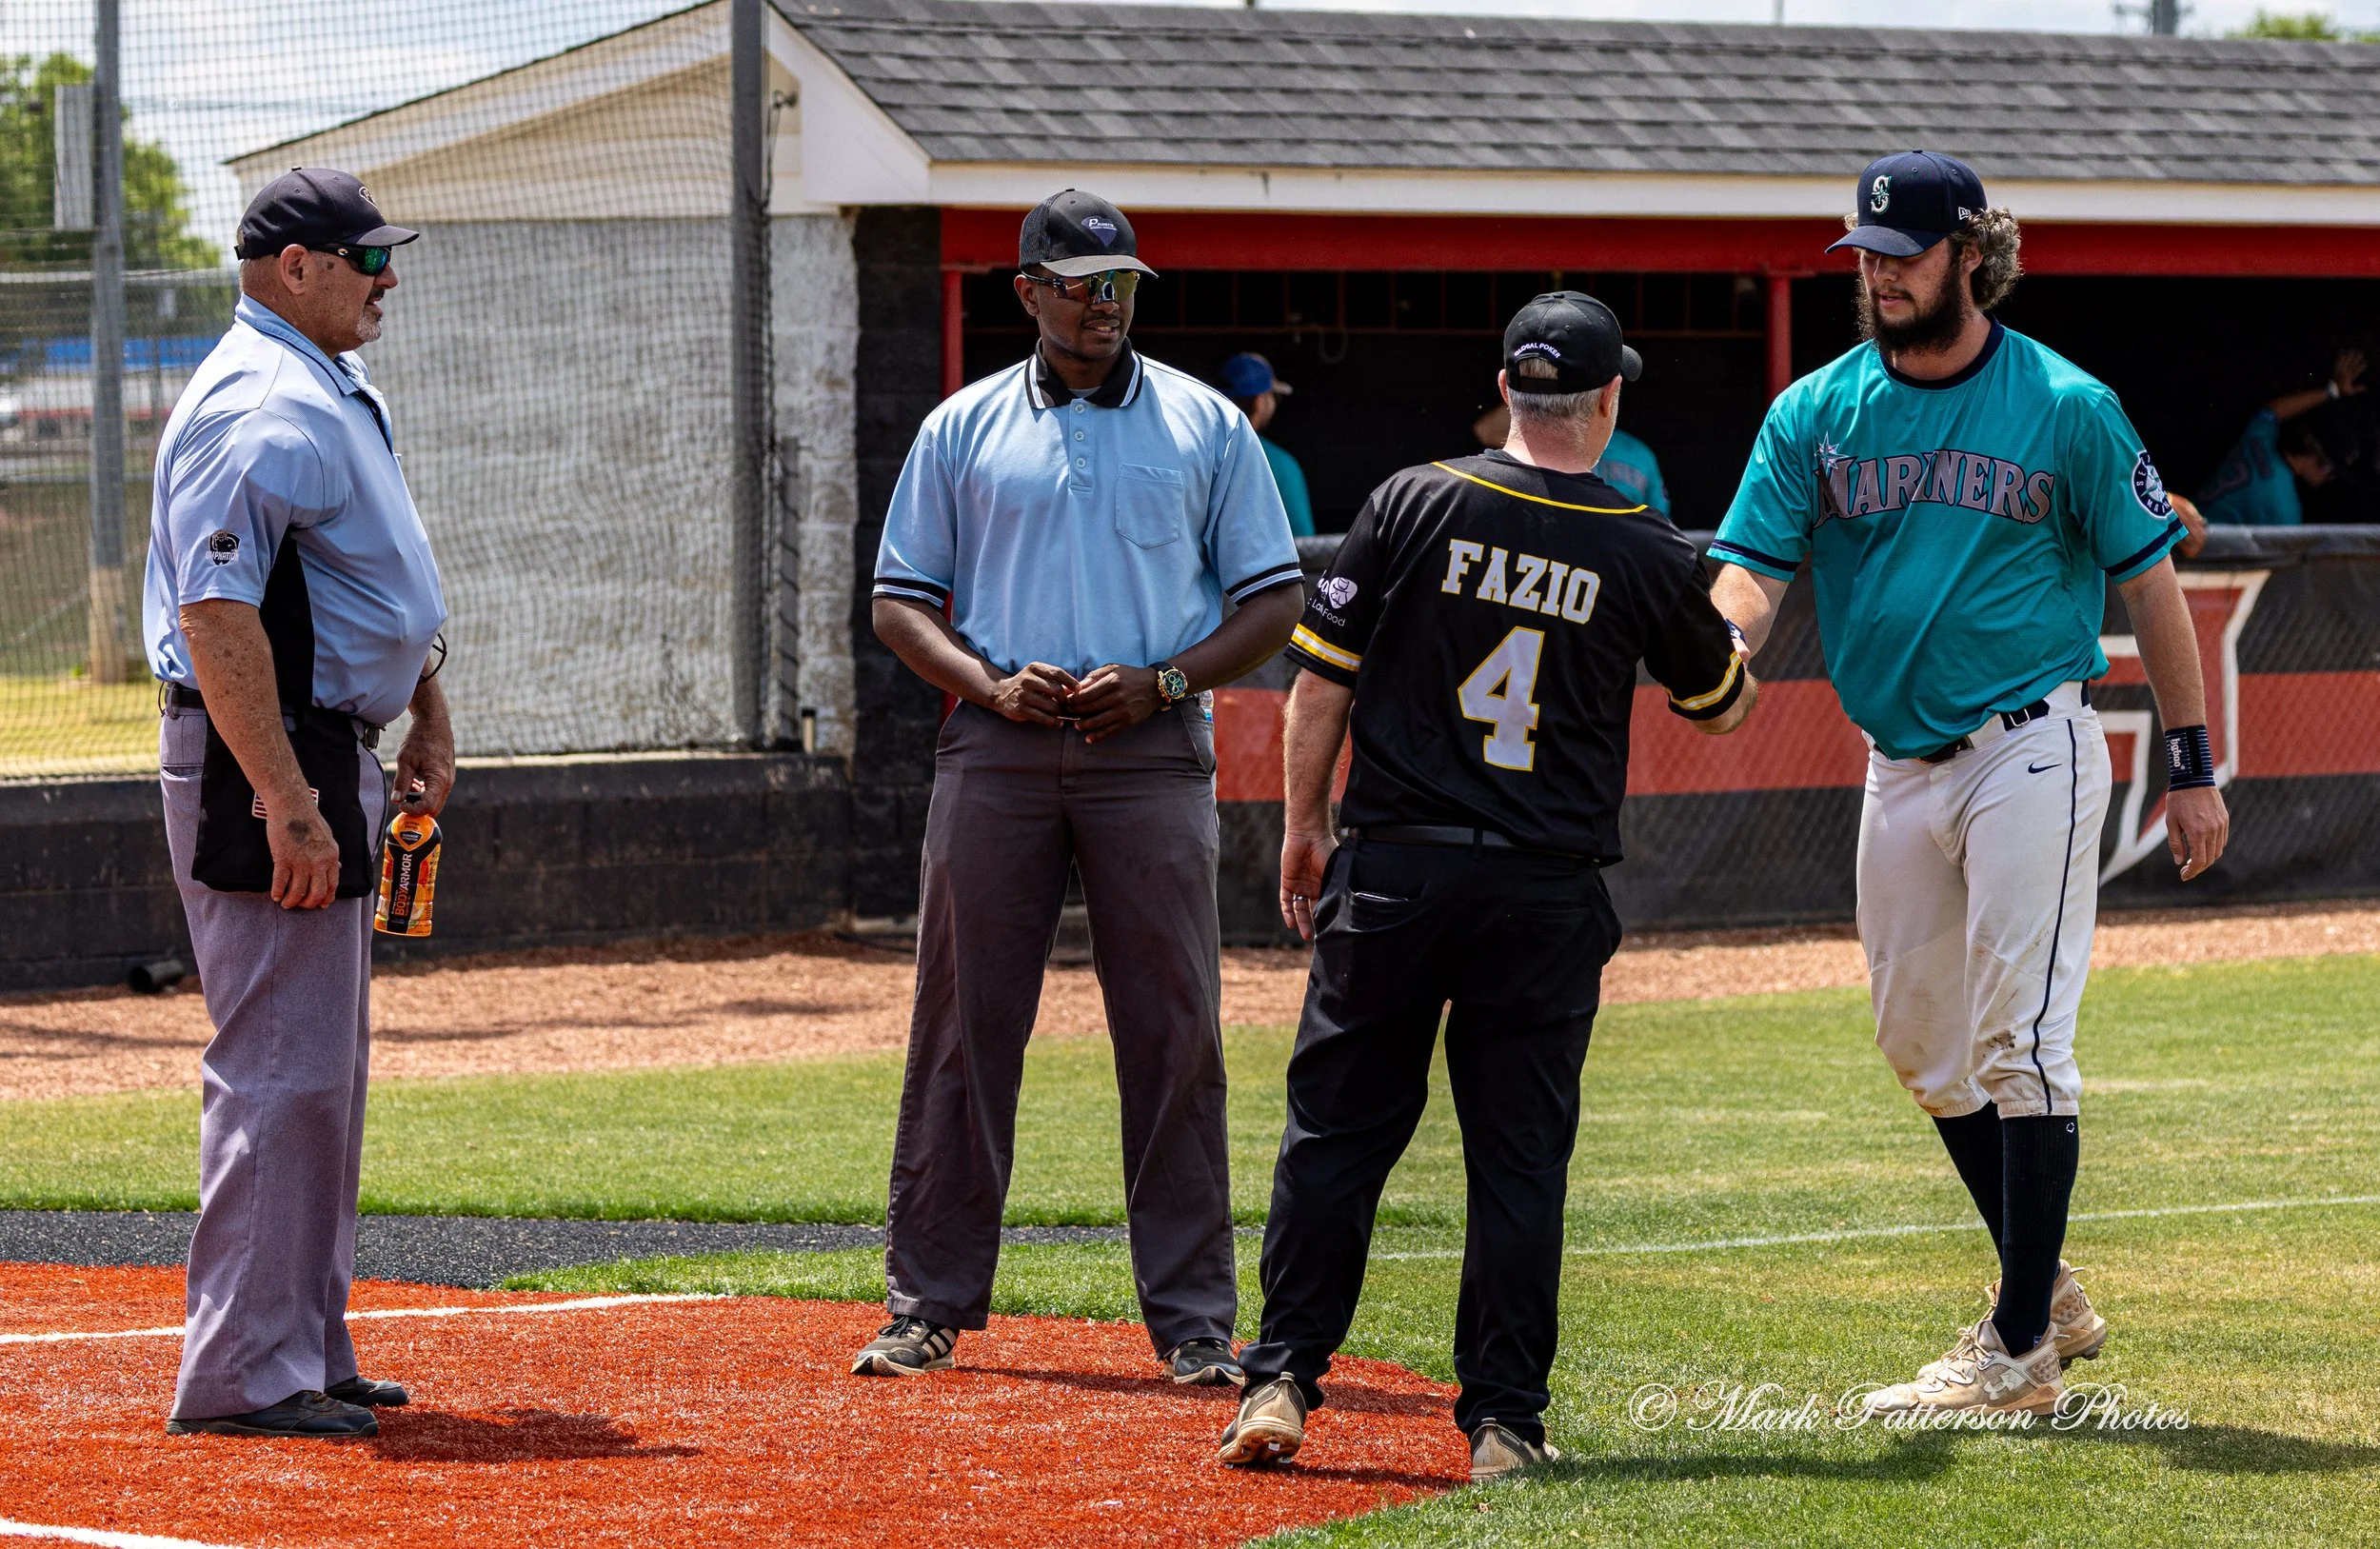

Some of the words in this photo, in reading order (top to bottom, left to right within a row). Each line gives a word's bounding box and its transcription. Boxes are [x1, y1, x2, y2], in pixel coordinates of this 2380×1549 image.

[1514, 343, 1538, 357] GLOBAL
[1538, 343, 1561, 359] POKER
[1812, 448, 2055, 530] MARINERS
[1321, 607, 1346, 627] Food
[1440, 538, 1601, 625] FAZIO
[1457, 626, 1540, 772] 4
[394, 853, 413, 917] BODYARMOR
